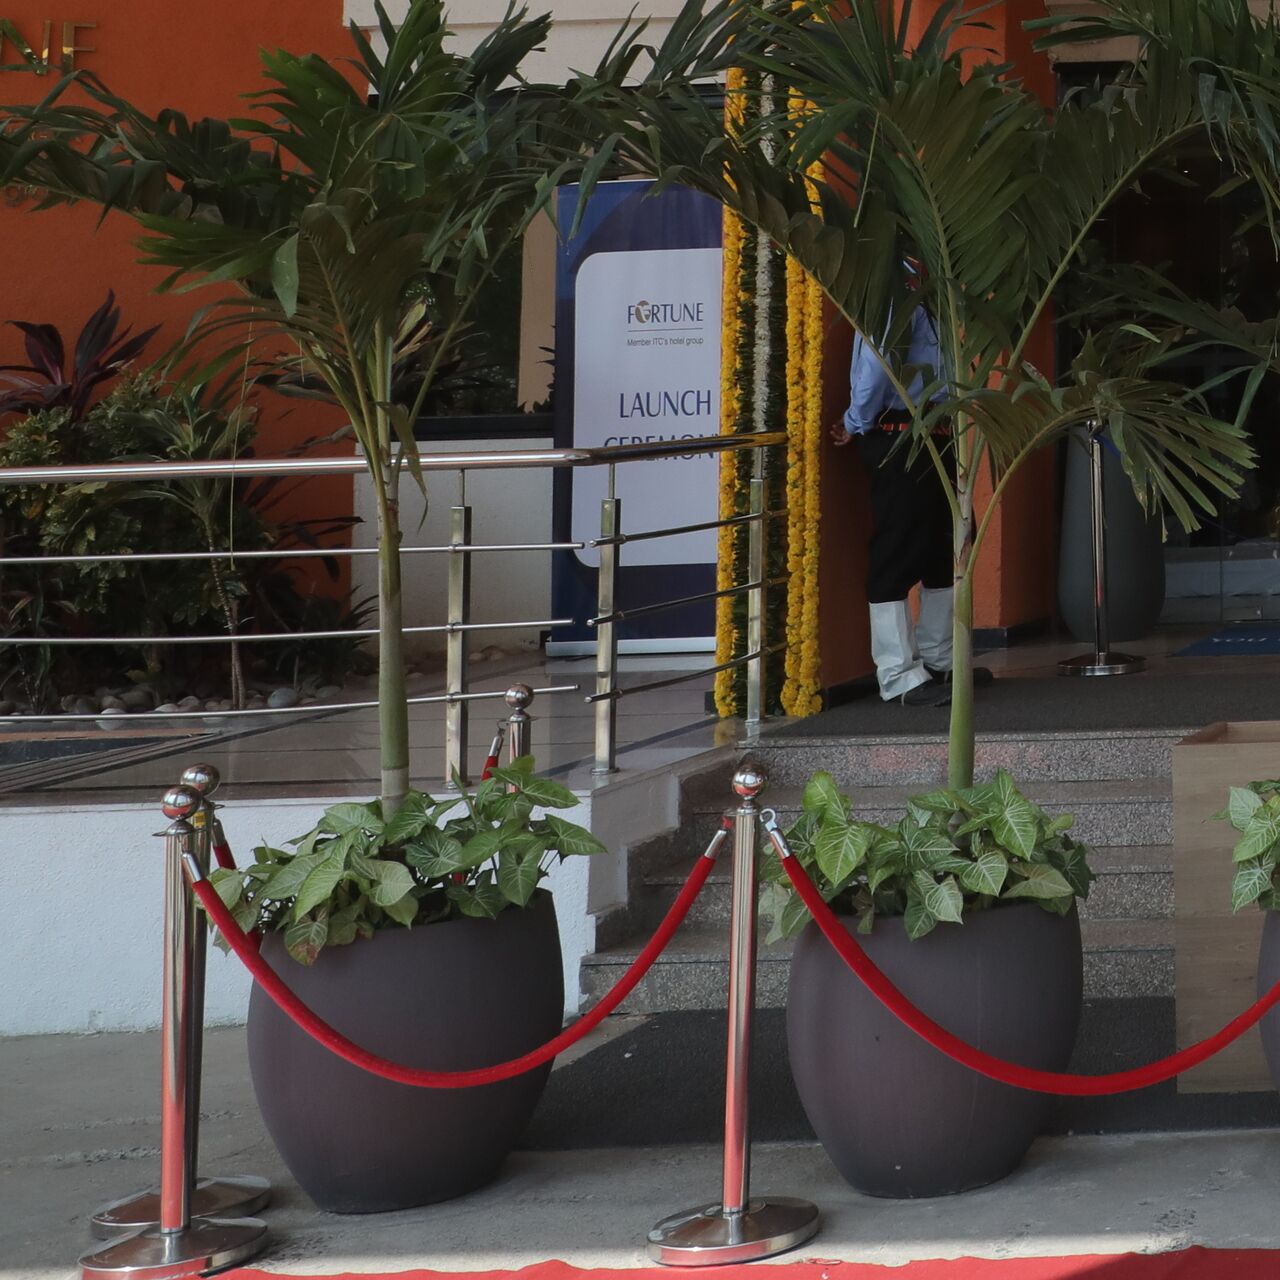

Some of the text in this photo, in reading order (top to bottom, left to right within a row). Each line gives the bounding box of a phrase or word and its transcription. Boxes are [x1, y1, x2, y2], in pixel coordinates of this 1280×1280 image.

[627, 300, 704, 324] FORTUNE
[627, 337, 704, 347] Member ITC's hotel group
[619, 389, 712, 419] LAUNCH
